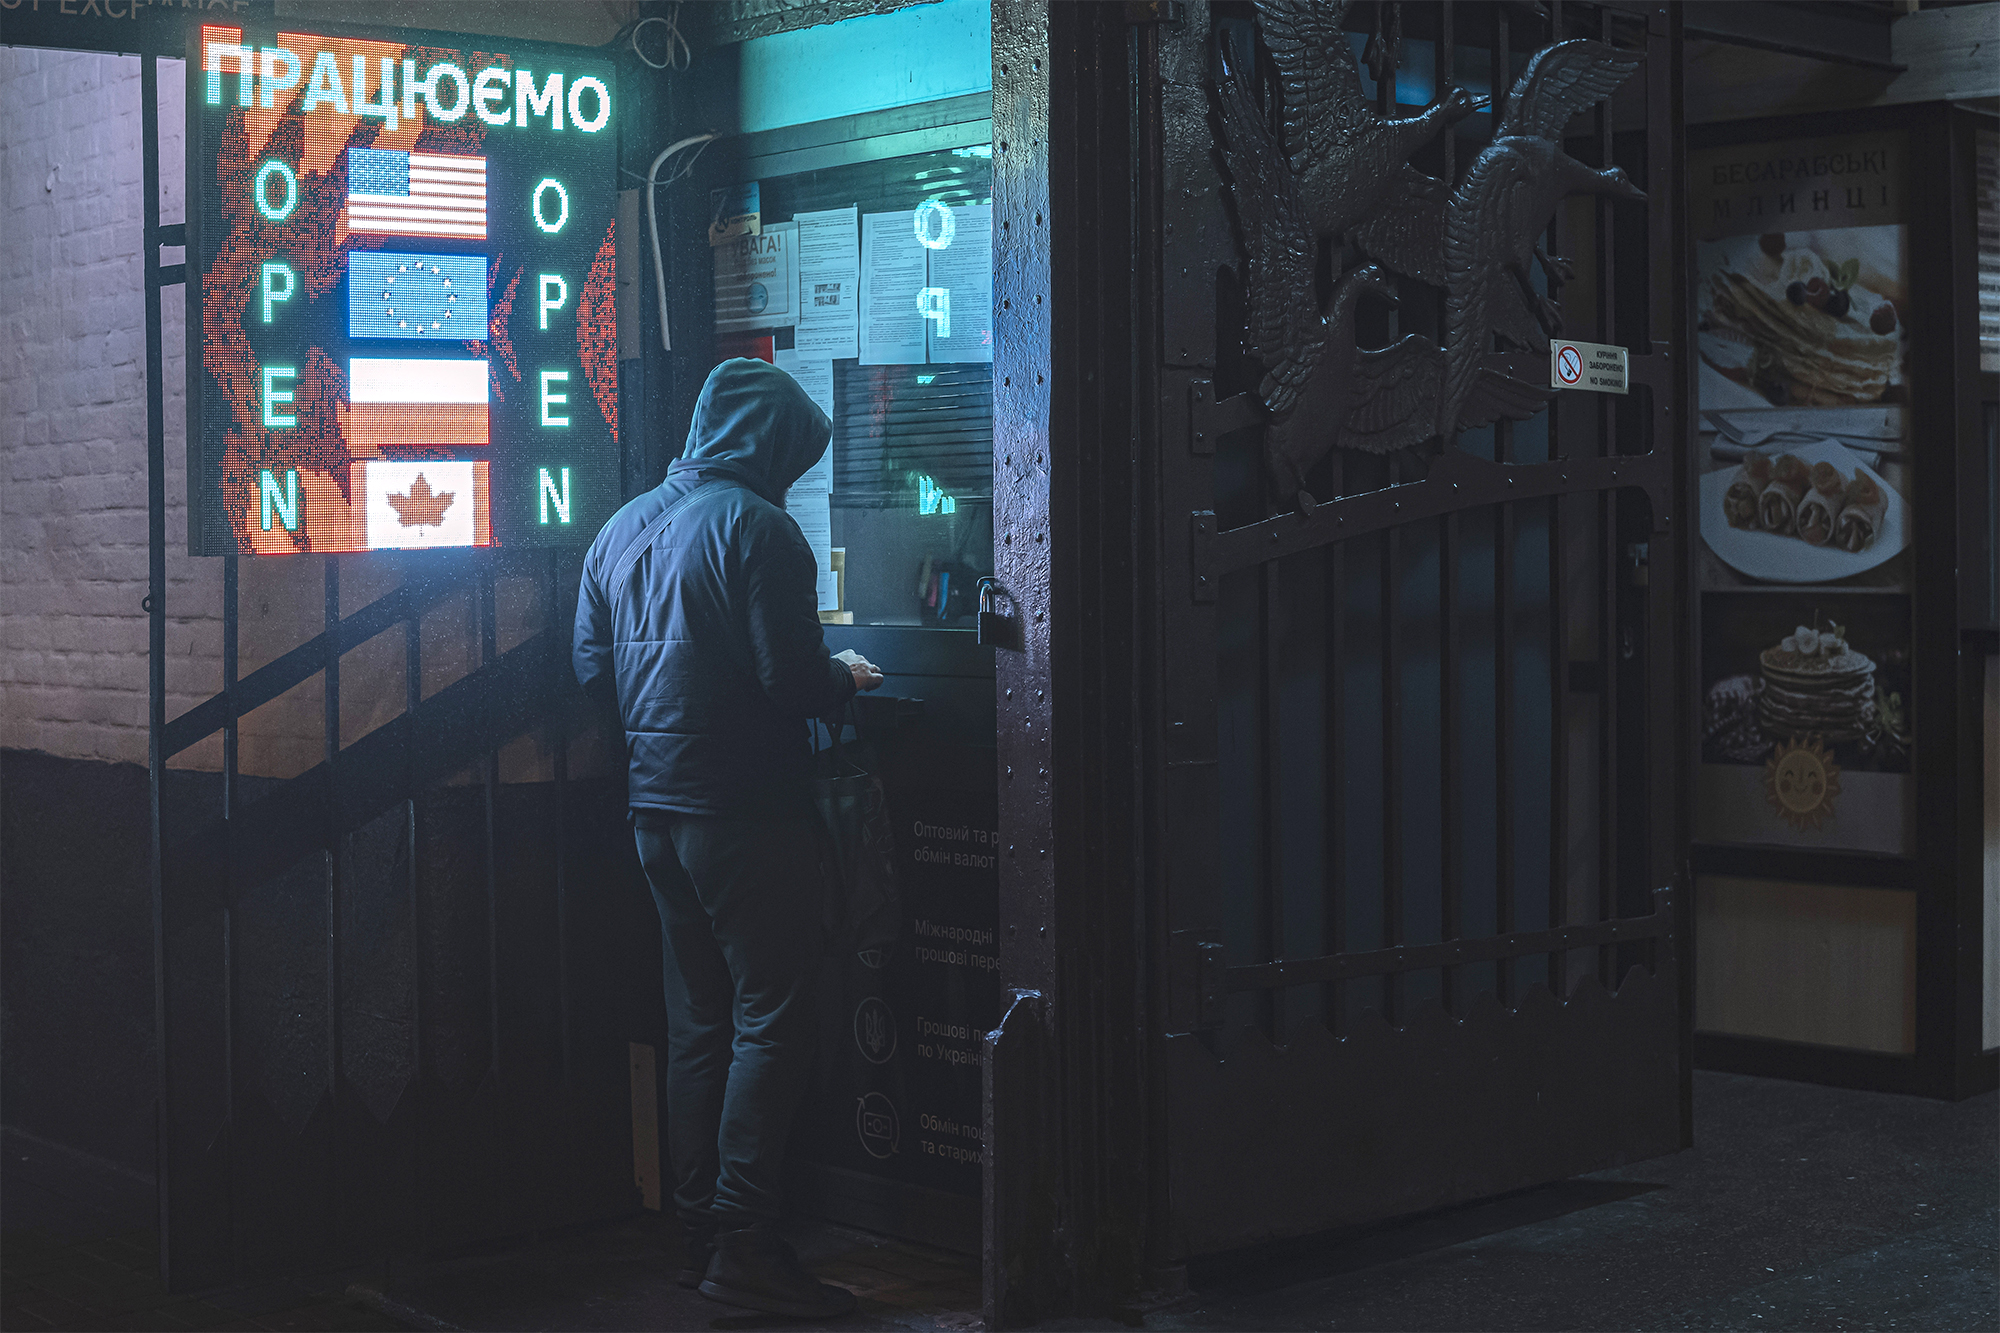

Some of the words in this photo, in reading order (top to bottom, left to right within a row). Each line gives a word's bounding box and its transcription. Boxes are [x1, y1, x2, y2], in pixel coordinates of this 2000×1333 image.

[205, 41, 611, 133] ПРАЦЮЄМО
[1712, 150, 1888, 186] БЕСАРАБСЬКІ
[254, 159, 299, 531] OPEN
[532, 177, 571, 524] OPEN
[1589, 377, 1598, 386] NO
[914, 820, 969, 841] Оптовий
[973, 829, 988, 843] та
[914, 846, 951, 865] обмін
[954, 853, 996, 869] валют
[915, 919, 993, 946] Міжнародні
[915, 946, 967, 964] грошові
[917, 1016, 970, 1040] Грошові
[917, 1043, 934, 1058] по
[936, 1043, 982, 1067] Україні
[920, 1113, 960, 1136] Обмін
[920, 1140, 936, 1155] та
[938, 1144, 984, 1165] старих
